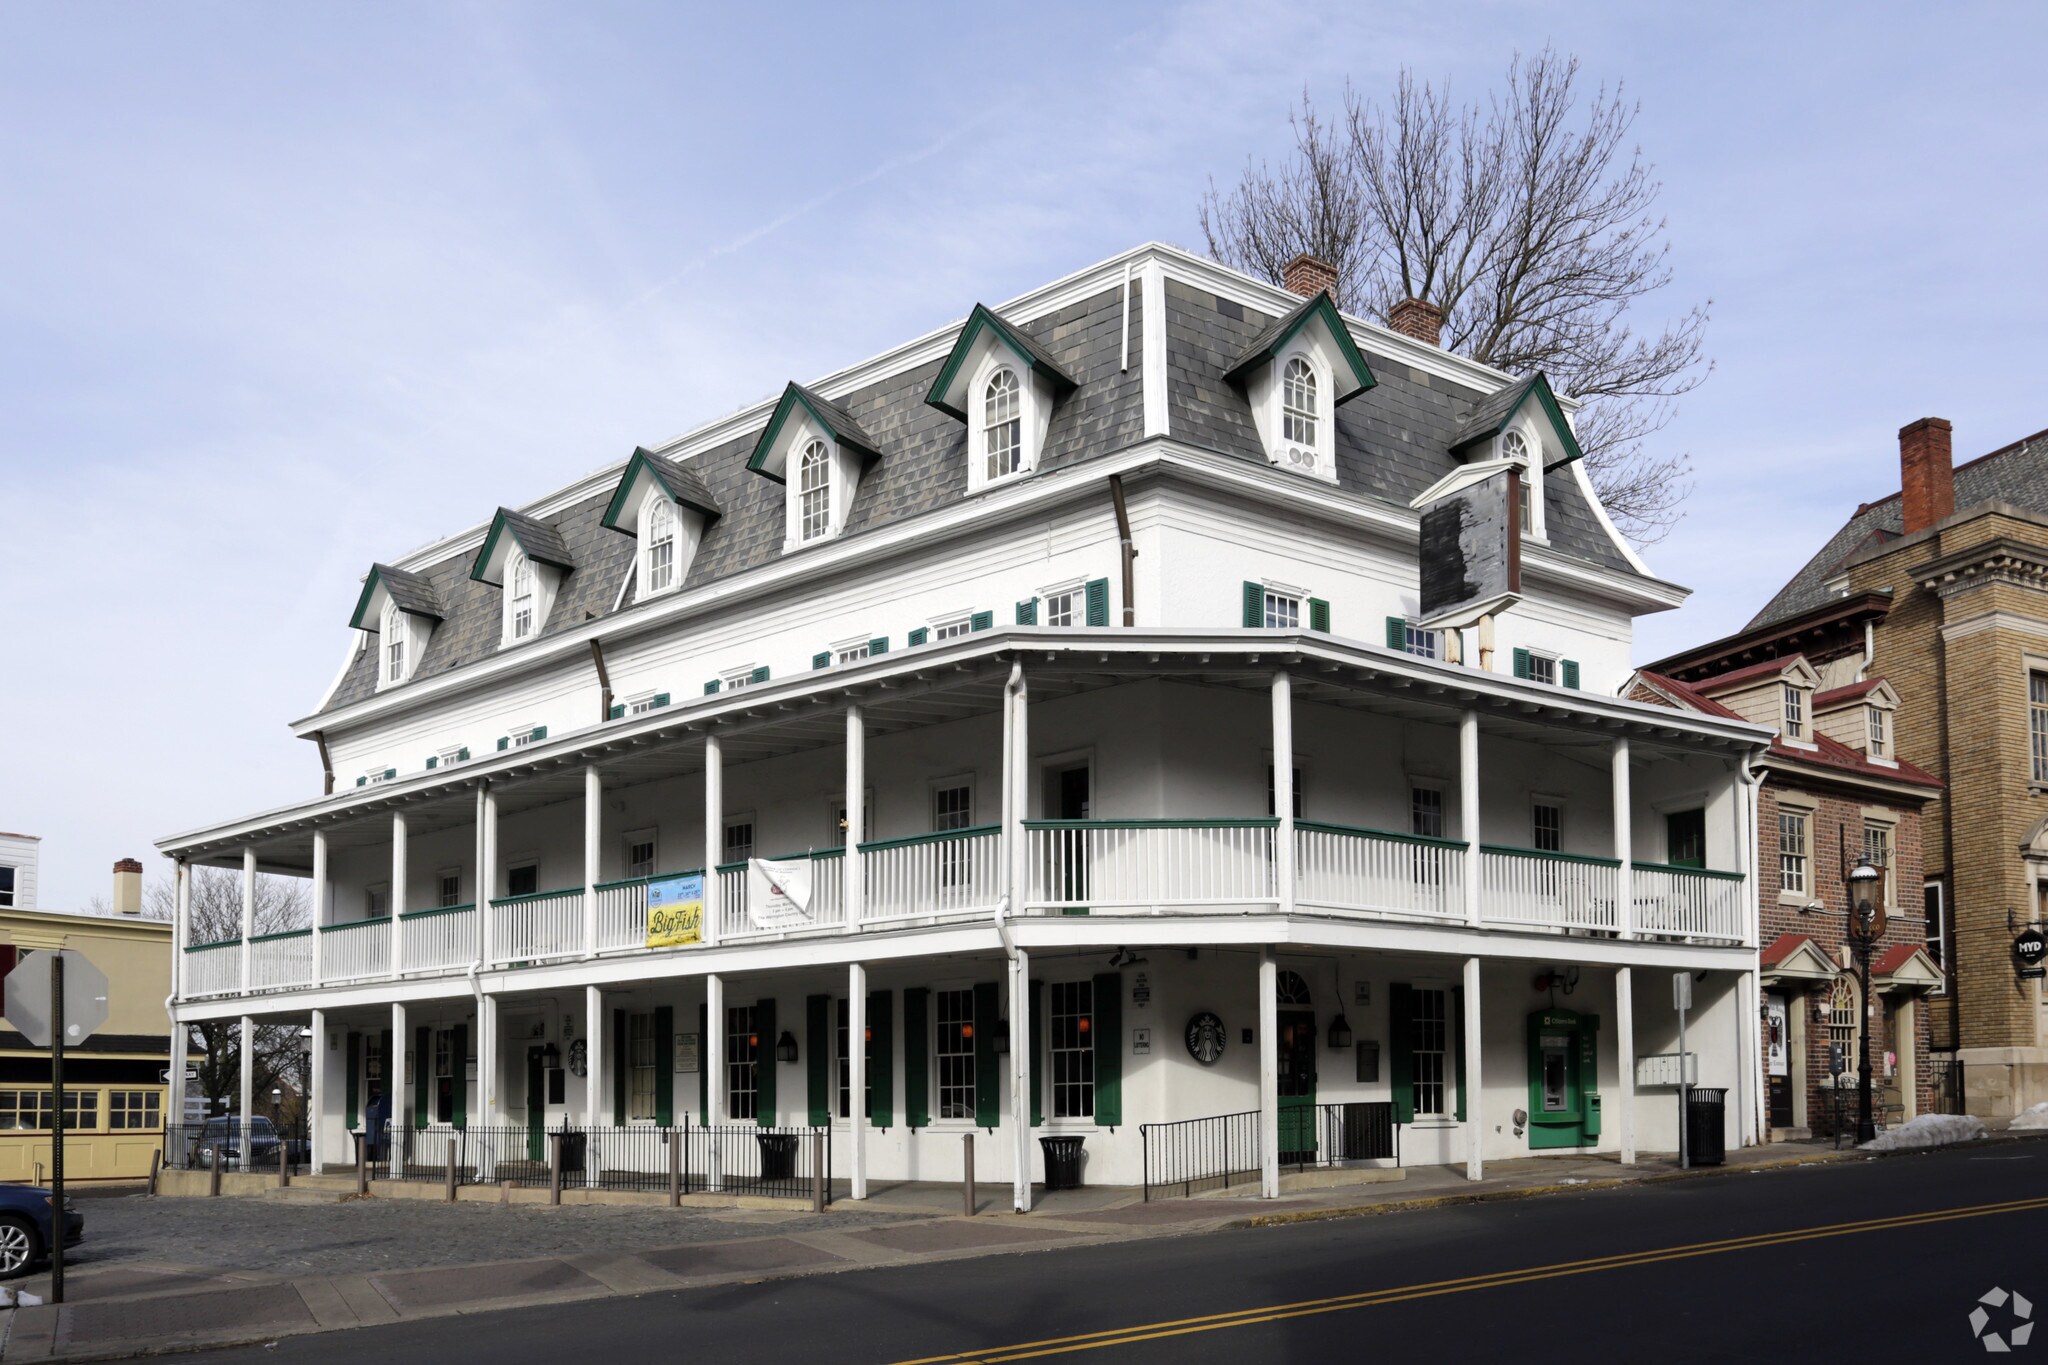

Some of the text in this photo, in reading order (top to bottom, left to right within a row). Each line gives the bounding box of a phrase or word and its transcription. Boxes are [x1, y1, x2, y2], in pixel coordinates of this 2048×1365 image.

[650, 905, 701, 938] Big Fish
[2018, 941, 2042, 953] MYD
